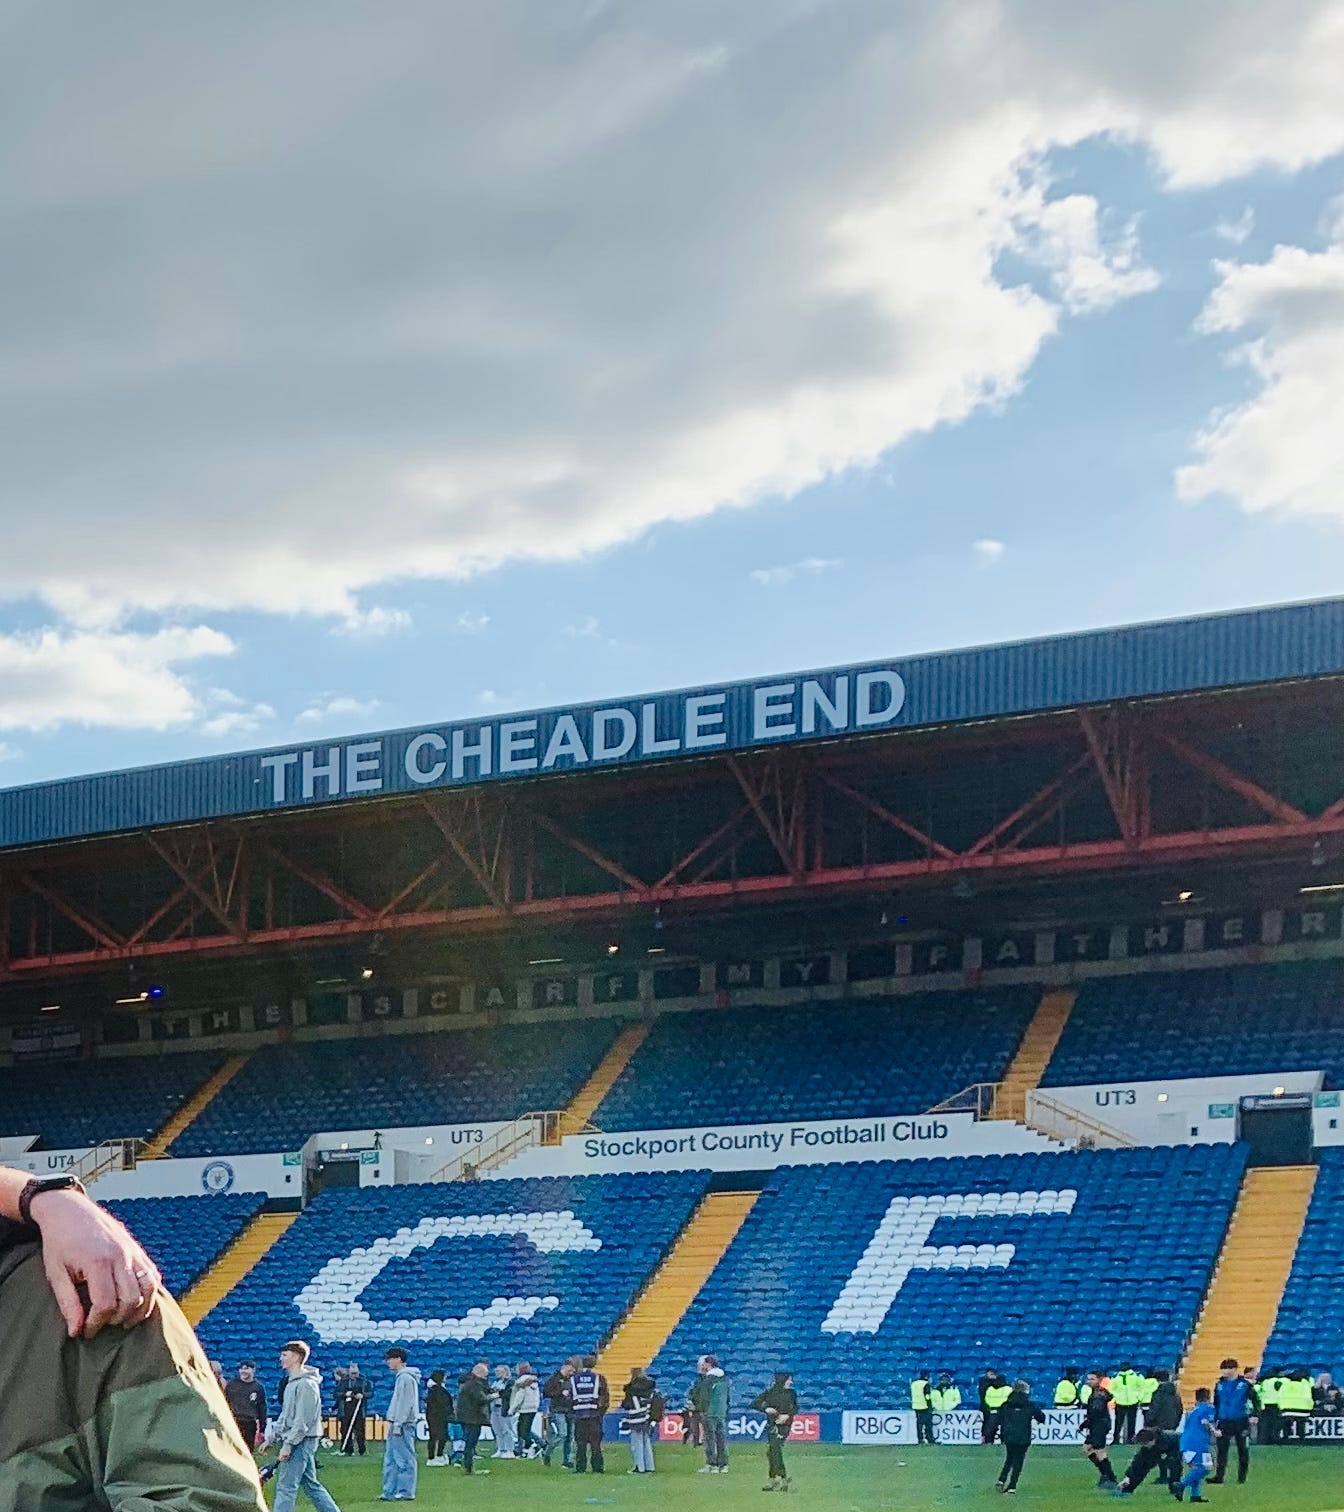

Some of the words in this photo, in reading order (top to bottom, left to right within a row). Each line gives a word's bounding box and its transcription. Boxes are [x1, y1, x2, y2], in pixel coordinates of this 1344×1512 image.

[260, 741, 383, 804] THE
[403, 692, 727, 786] CHEADLE
[752, 669, 905, 741] END
[929, 911, 1326, 967] FATHER
[1095, 1090, 1137, 1107] UT3
[451, 1129, 483, 1145] UT3
[584, 1134, 695, 1160] Stockport
[701, 1129, 786, 1152] County
[790, 1122, 885, 1147] Football
[892, 1120, 949, 1142] Club
[47, 1155, 75, 1170] UT4
[294, 1208, 602, 1343] C
[820, 1188, 1078, 1335] F
[727, 1415, 768, 1439] sky
[790, 1418, 815, 1435] et
[931, 1413, 984, 1426] ORWA
[931, 1428, 981, 1441] USINE
